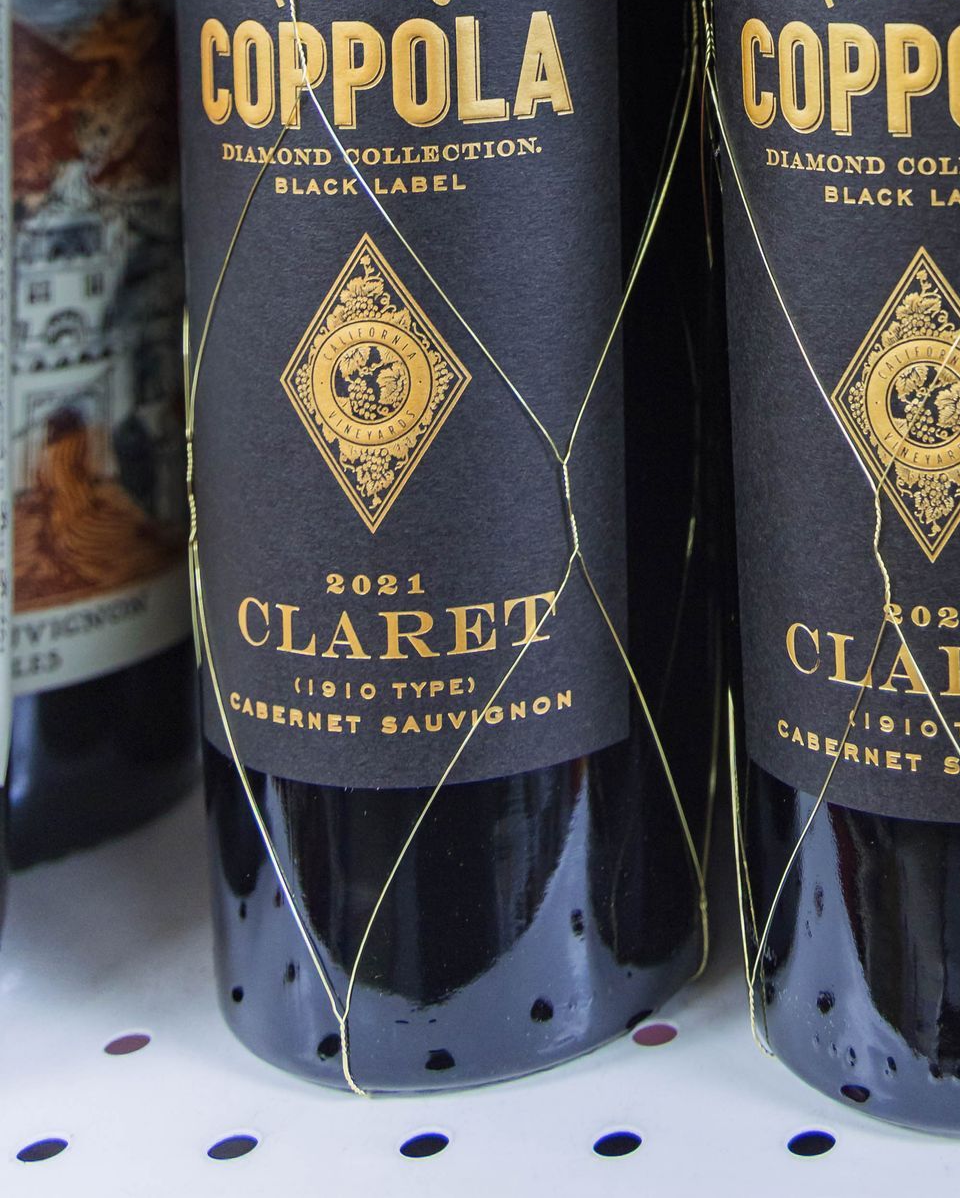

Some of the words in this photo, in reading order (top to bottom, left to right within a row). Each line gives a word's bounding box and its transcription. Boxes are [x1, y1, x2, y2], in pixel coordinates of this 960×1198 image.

[201, 10, 574, 129] COPPOLA
[222, 143, 332, 166] DIAMOND
[766, 149, 886, 175] DIAMOND
[275, 177, 358, 196] BLACK
[375, 174, 466, 195] LABEL
[824, 186, 913, 207] BLACK
[324, 326, 417, 361] CALIFORNIA
[328, 409, 416, 441] VINEYARDS
[326, 573, 425, 595] 2021
[238, 591, 556, 660] CLARET
[294, 677, 376, 700] (1910
[392, 677, 476, 699] TYPE)
[230, 691, 361, 734] CABERNET
[381, 690, 573, 734] SAUVIGNON
[849, 710, 938, 737] (1910
[777, 719, 922, 772] CABERNET
